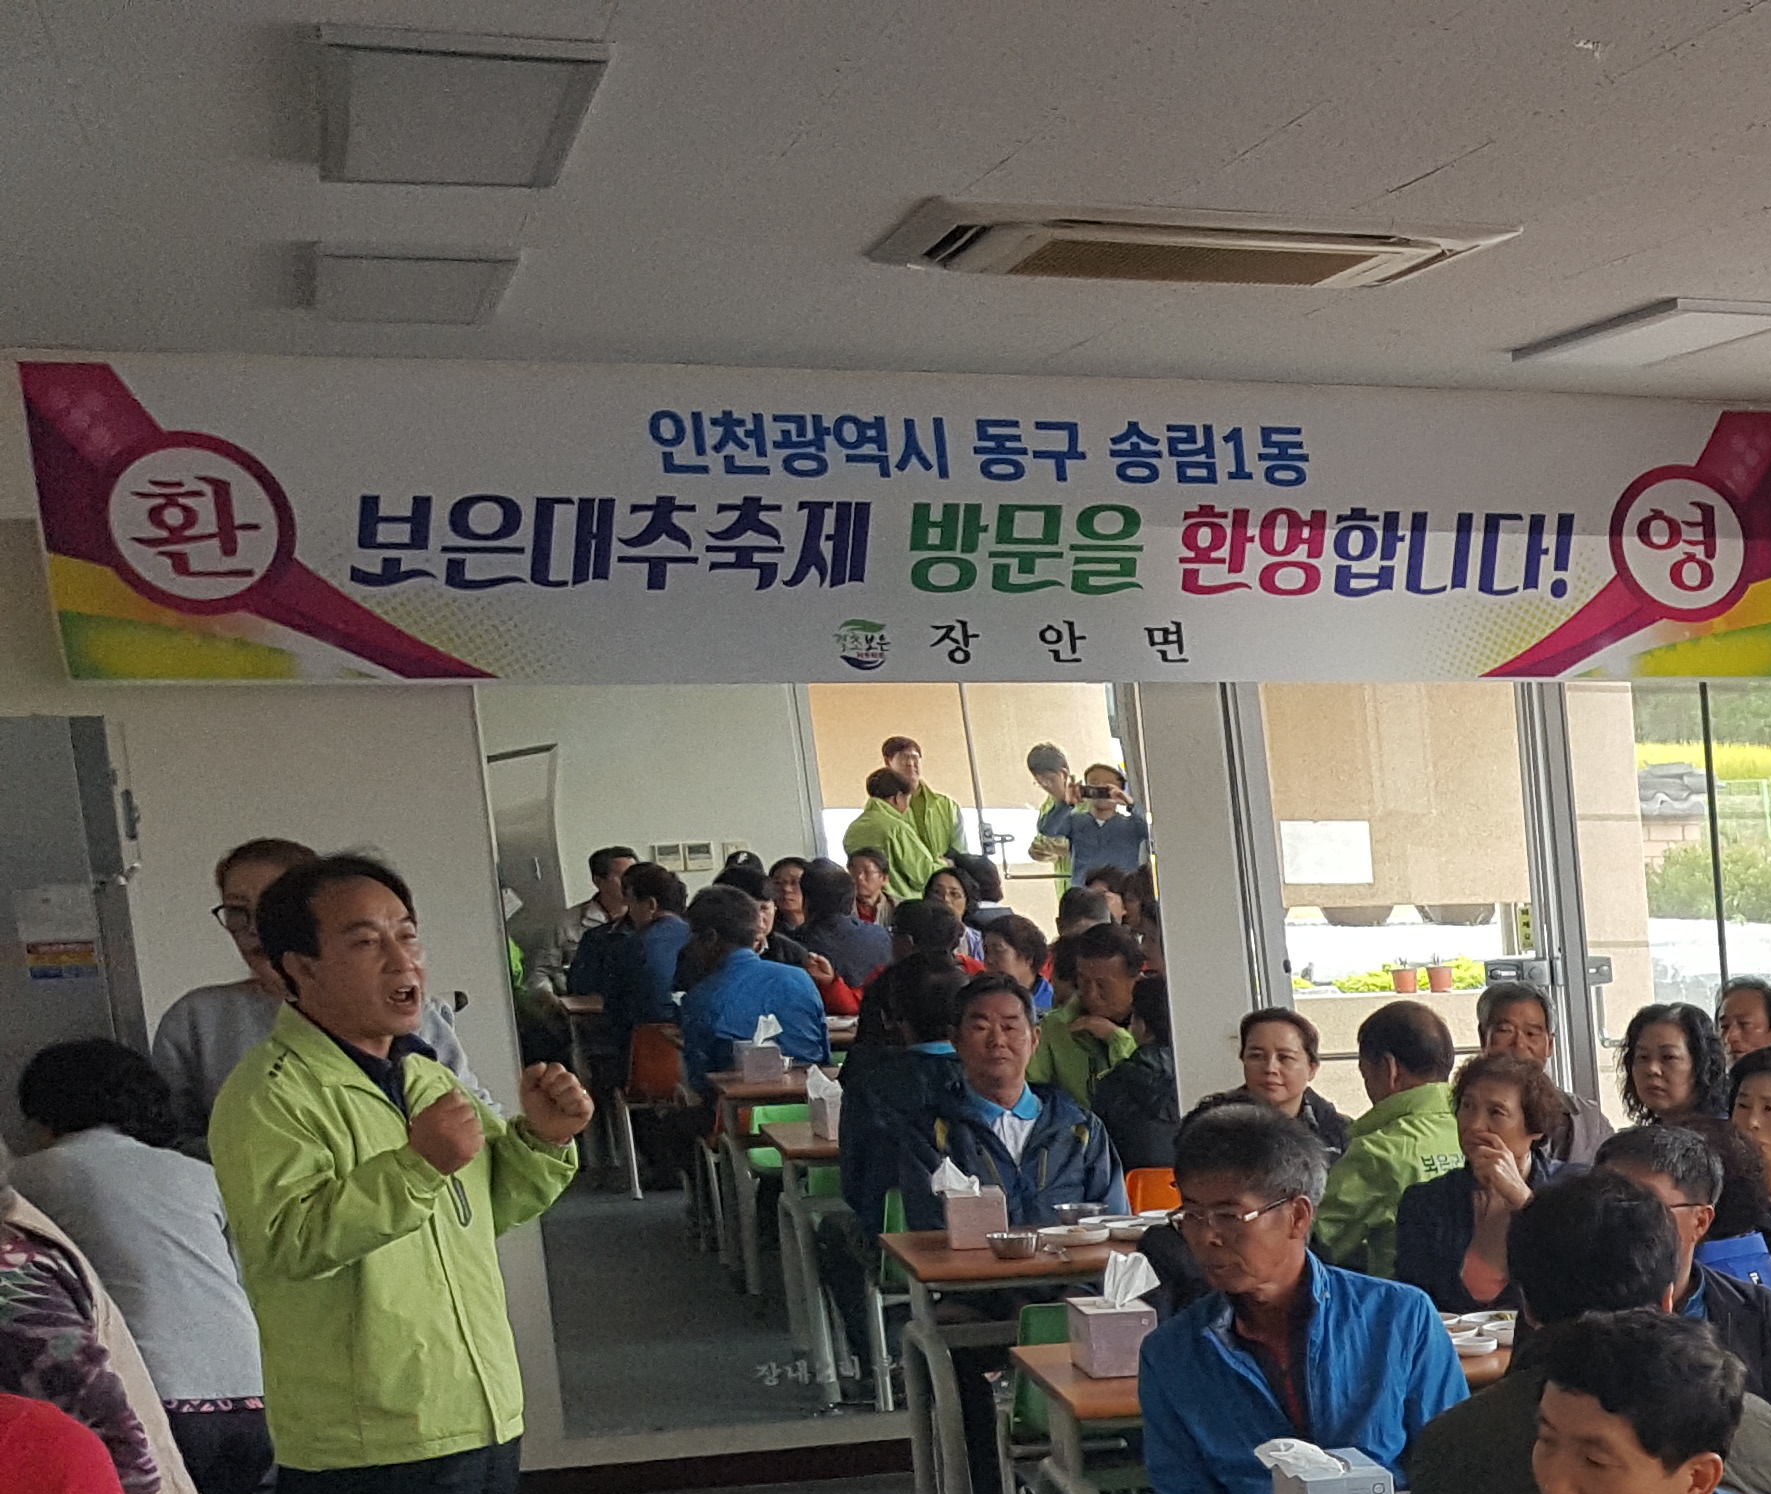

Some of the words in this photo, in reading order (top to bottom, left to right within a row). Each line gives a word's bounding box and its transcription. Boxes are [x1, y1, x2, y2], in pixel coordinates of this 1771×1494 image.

[648, 409, 950, 480] 인천광역시
[972, 418, 1086, 483] 동구
[1108, 421, 1310, 488] 송림1동
[130, 476, 260, 579] 환
[350, 494, 872, 591] 보은대추축제
[909, 501, 1145, 595] 방문을
[1178, 503, 1574, 598] 환영합니다!
[1636, 500, 1720, 592] 영
